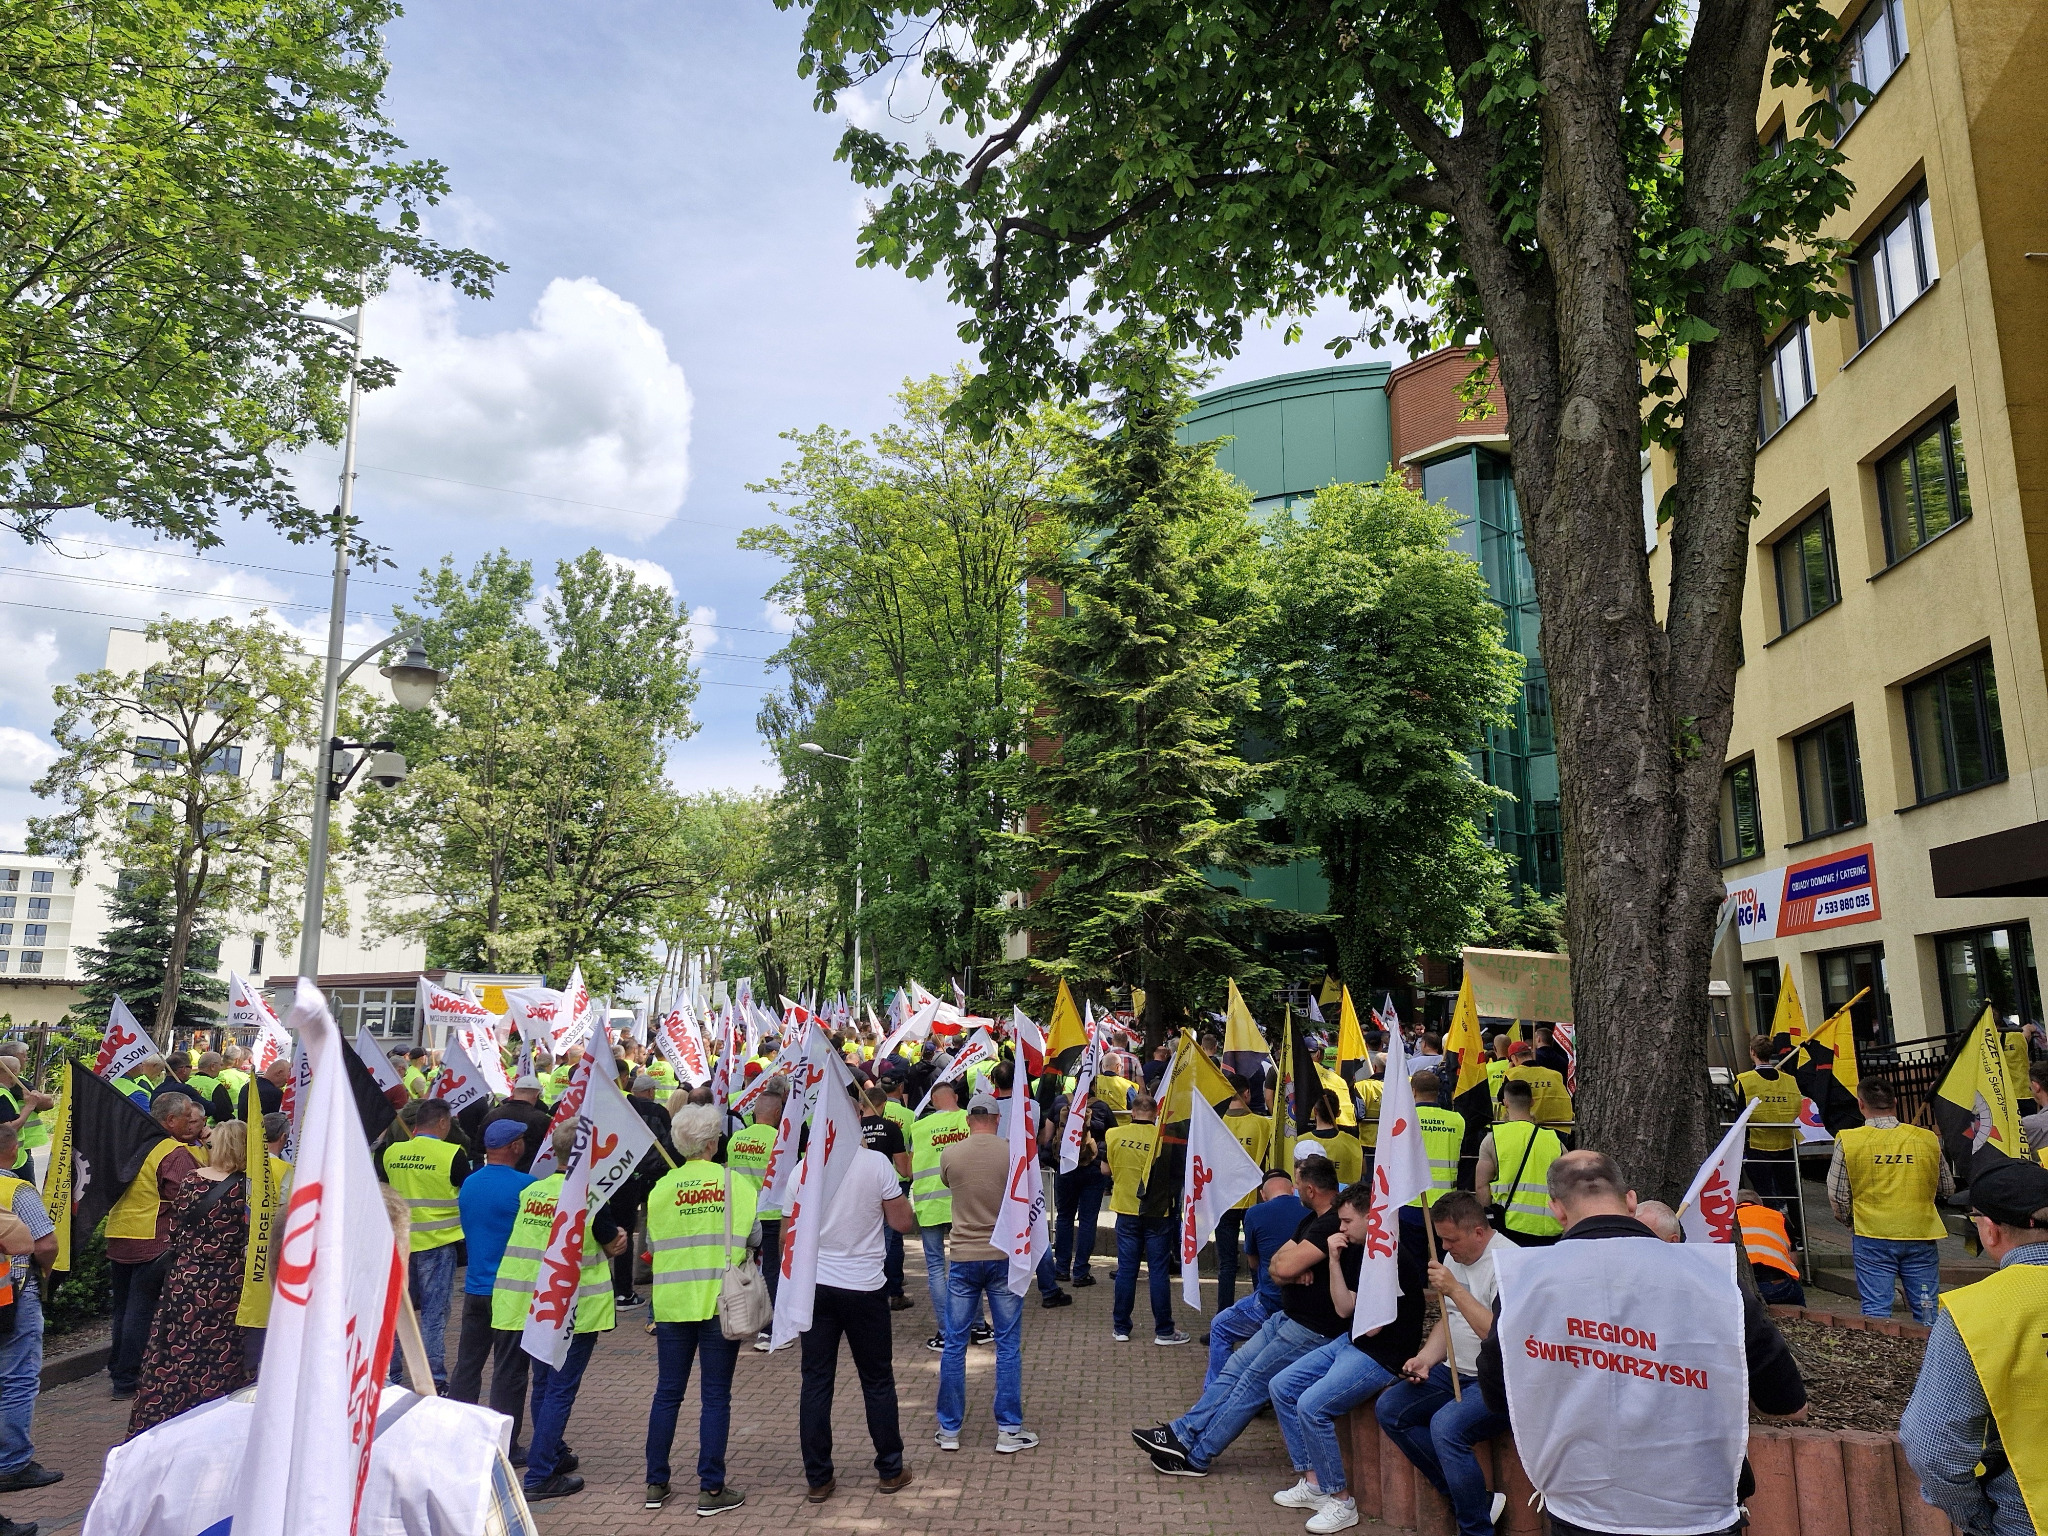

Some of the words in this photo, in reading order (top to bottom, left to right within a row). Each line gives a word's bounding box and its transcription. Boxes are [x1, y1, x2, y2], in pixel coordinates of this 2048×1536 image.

[1810, 875, 1835, 887] DOMOWE
[1839, 864, 1867, 880] CATERING
[1824, 901, 1839, 914] 533
[1839, 898, 1854, 910] 880
[1855, 893, 1870, 907] 035
[1549, 958, 1569, 973] MU
[1499, 970, 1518, 984] TU
[233, 1012, 254, 1021] MOZ
[1501, 1004, 1523, 1018] LAT
[1534, 1004, 1572, 1021] PRAC
[1985, 1028, 1999, 1059] MZZE
[1121, 1140, 1151, 1151] ZZZE
[1239, 1137, 1252, 1146] ZE
[399, 1154, 426, 1162] SŁUŻBY
[1874, 1155, 1914, 1164] ZZZE
[261, 1134, 272, 1208] Dystrybucja
[389, 1163, 436, 1171] PORZĄDKOWE
[676, 1179, 701, 1188] NSZZ
[529, 1190, 548, 1198] NSZZ
[680, 1204, 725, 1216] RZESZÓW
[259, 1212, 269, 1241] PGE
[523, 1218, 552, 1228] RZESZÓ
[253, 1245, 268, 1282] MZZE
[1566, 1317, 1657, 1351] REGION
[1524, 1335, 1708, 1390] ŚWIĘTOKRZYSKI
